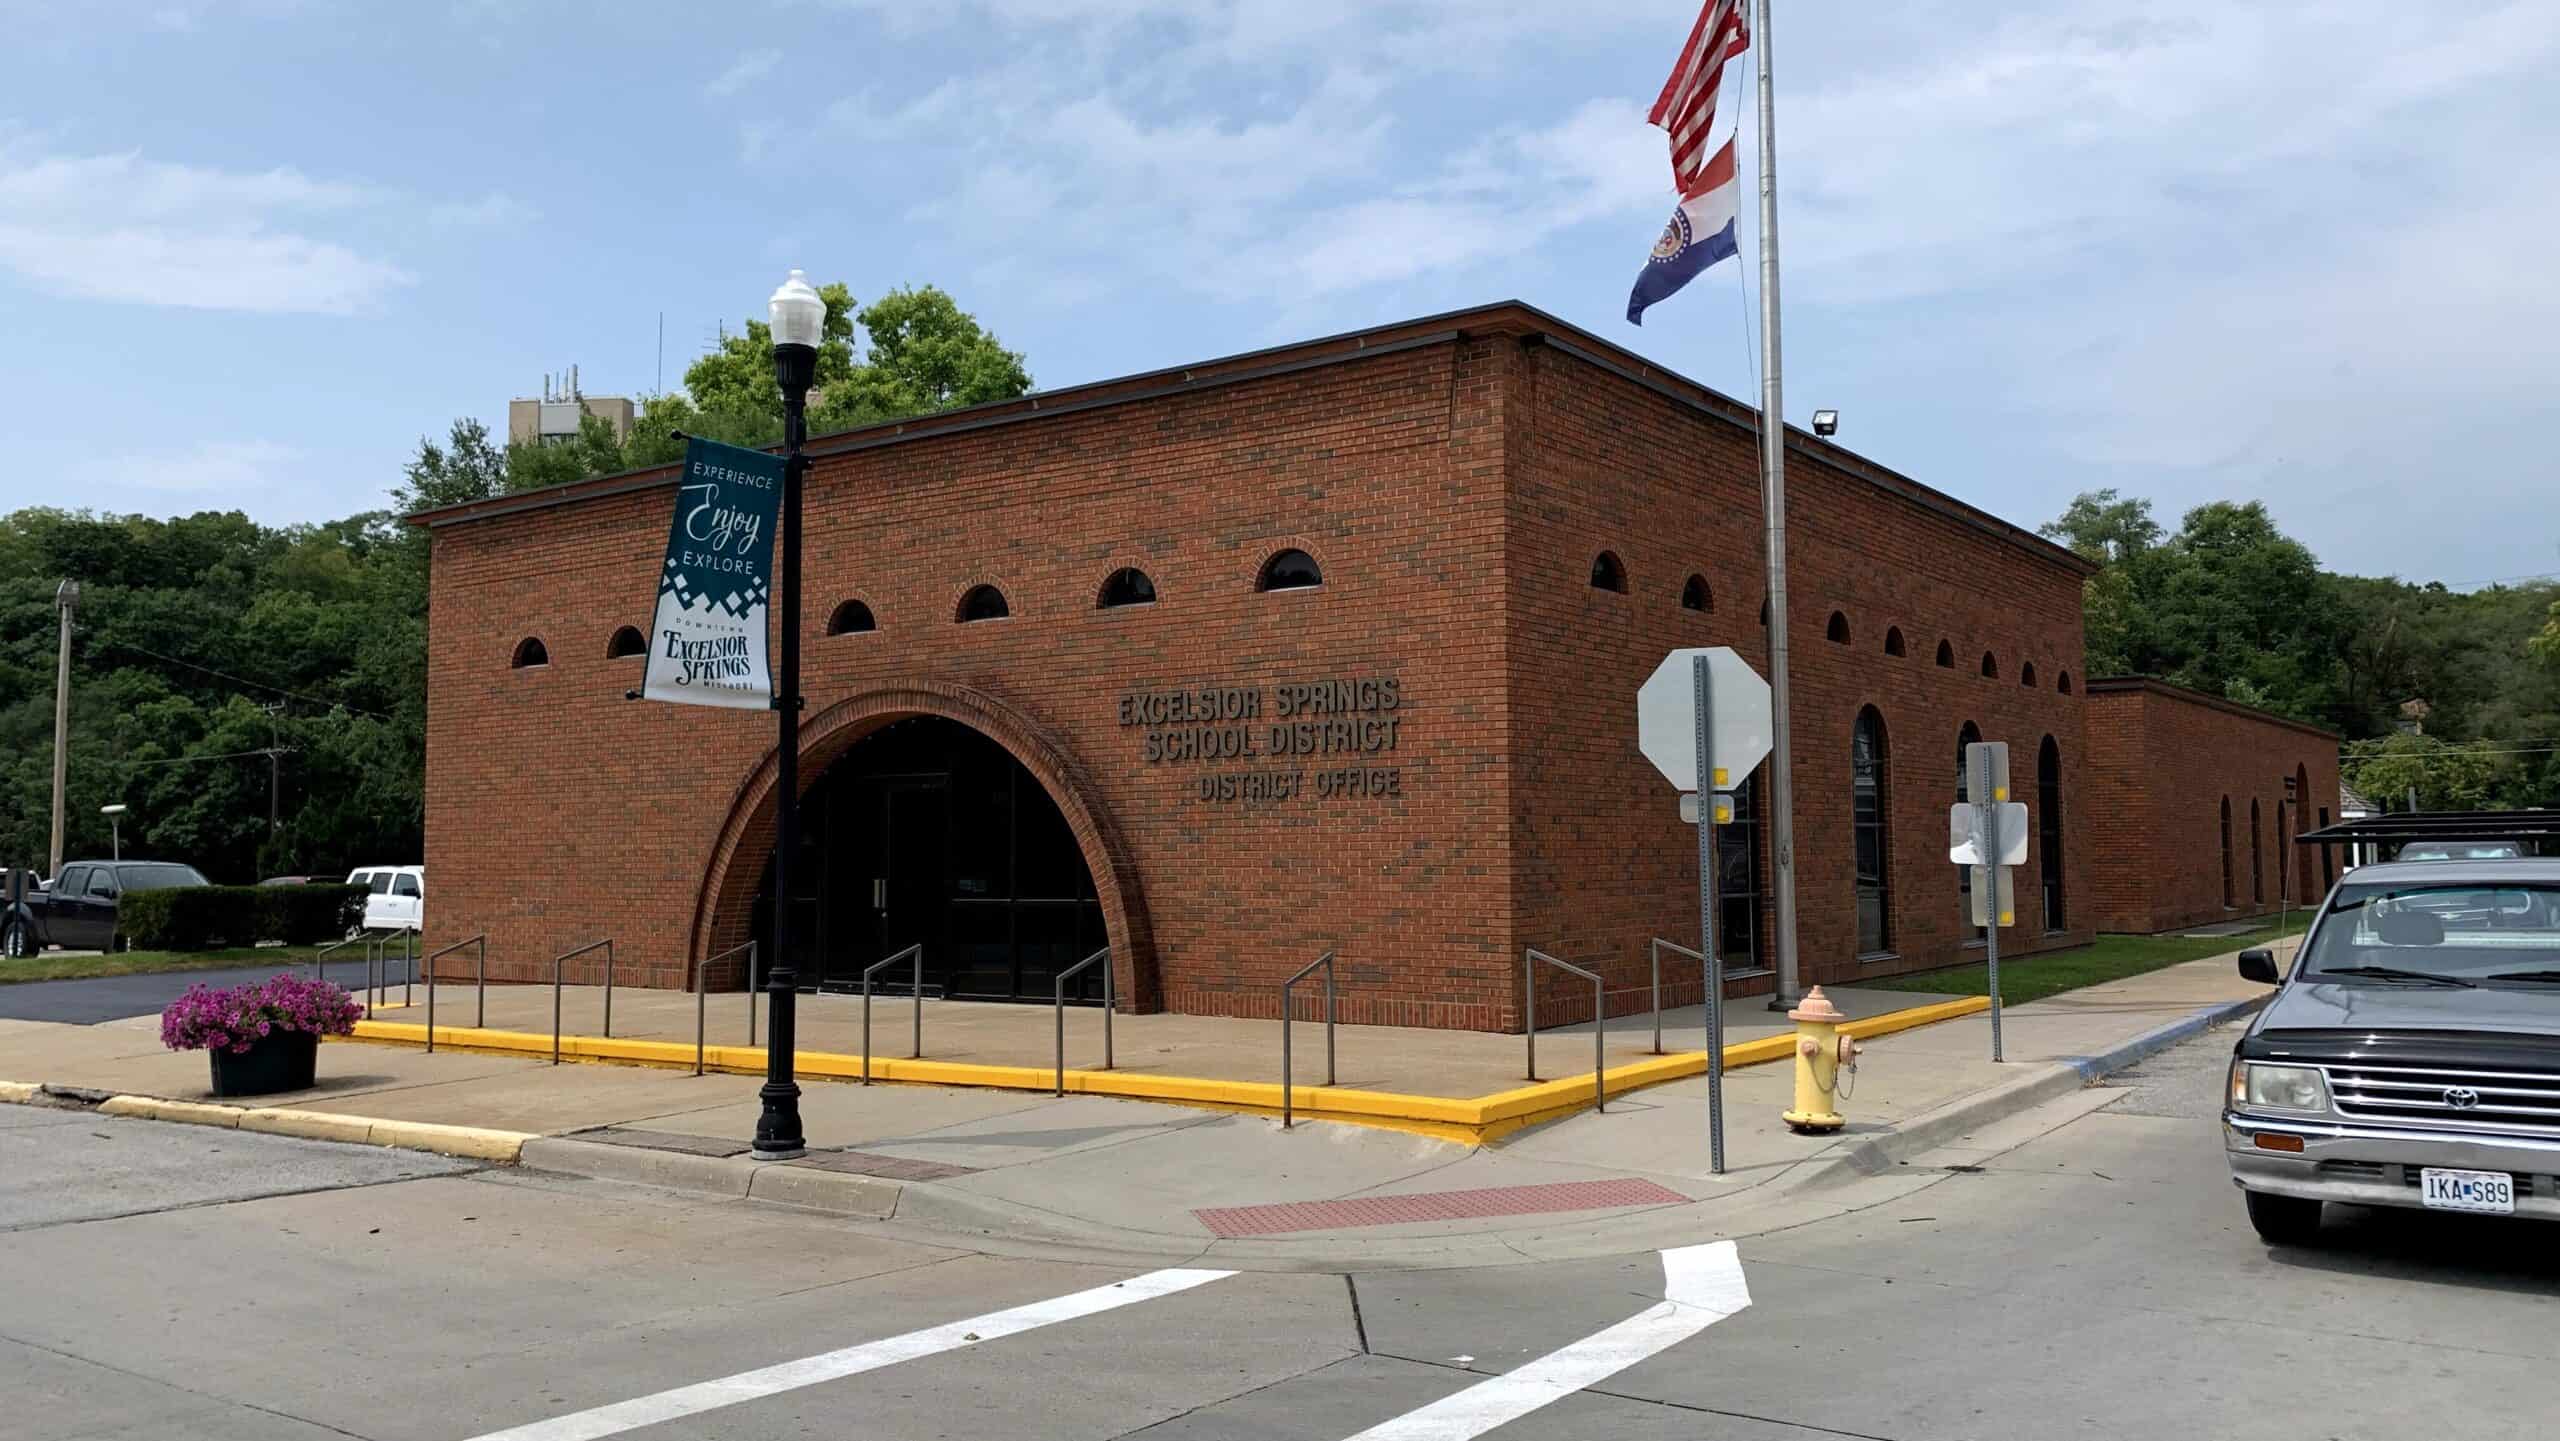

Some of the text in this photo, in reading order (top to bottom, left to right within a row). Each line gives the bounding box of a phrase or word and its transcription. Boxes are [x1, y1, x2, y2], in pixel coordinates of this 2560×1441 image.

[693, 461, 773, 490] EXPERIENCE
[681, 482, 760, 555] Enjoy
[682, 550, 754, 575] EXPLORE
[1118, 678, 1399, 725] EXCELSIOR SPRINGS
[1146, 716, 1399, 762] SCHOOL DISTRICT
[1201, 767, 1400, 801] DISTRICT OFFICE
[2472, 1181, 2510, 1204] S89
